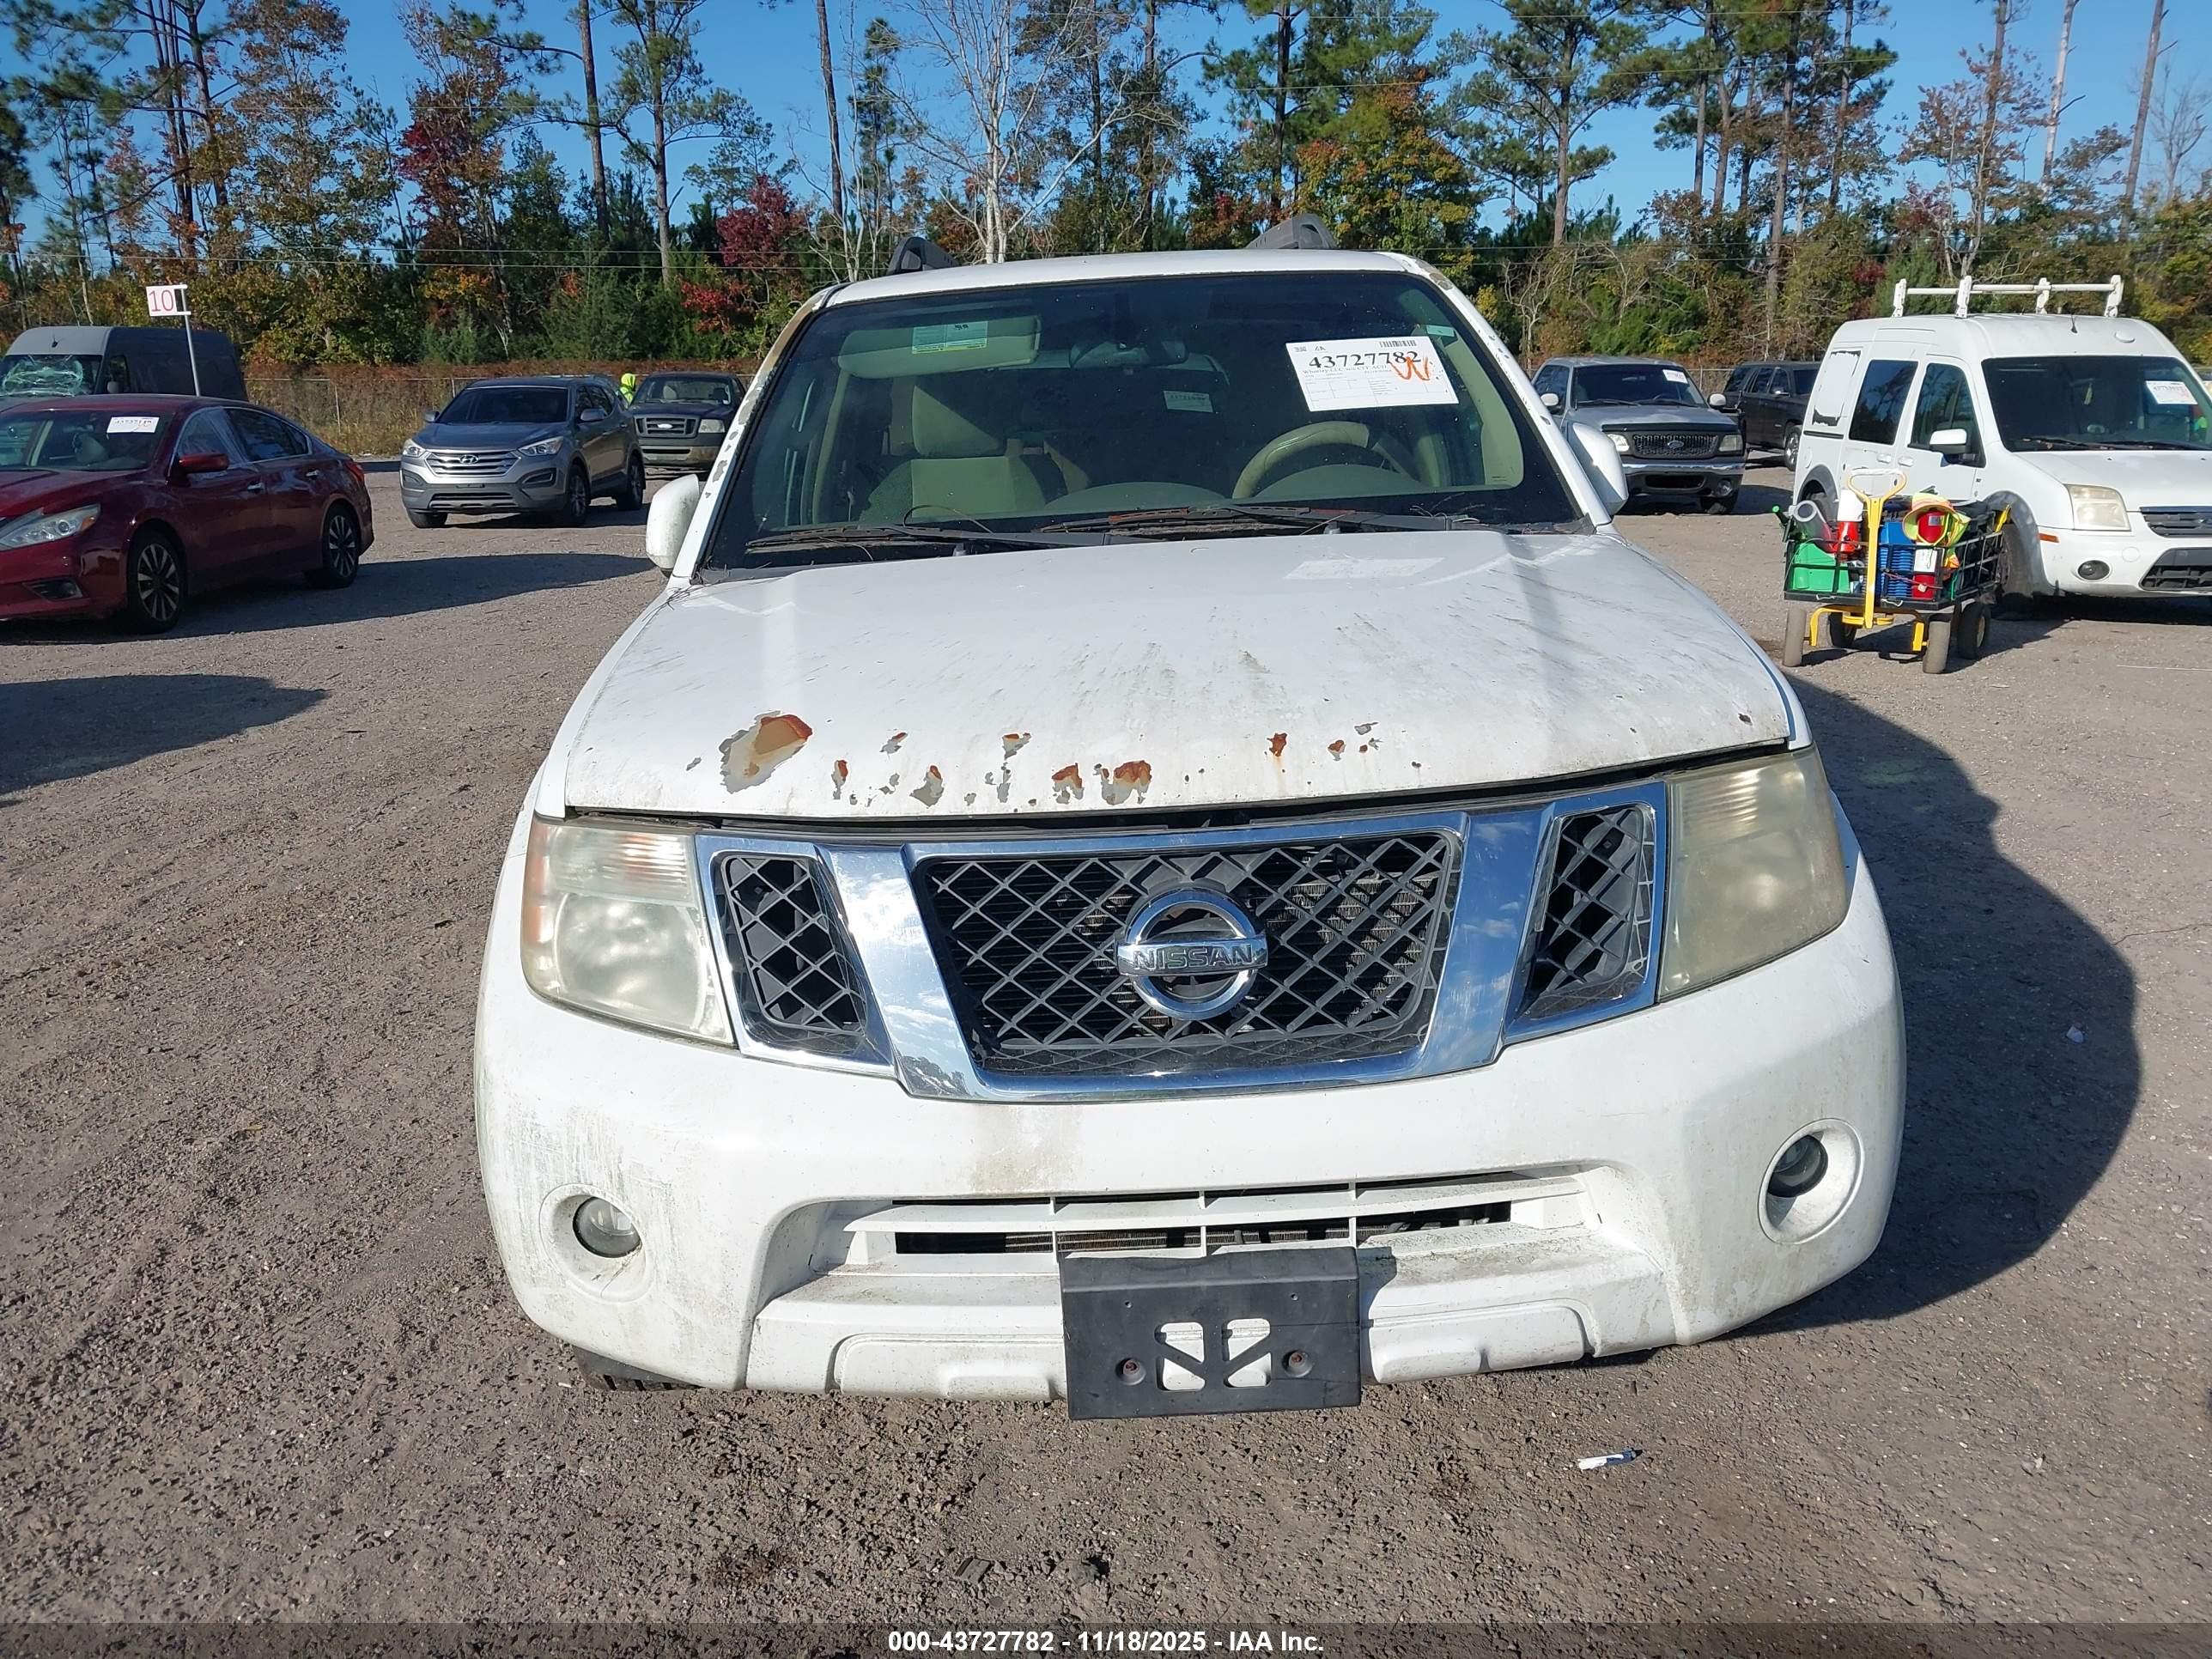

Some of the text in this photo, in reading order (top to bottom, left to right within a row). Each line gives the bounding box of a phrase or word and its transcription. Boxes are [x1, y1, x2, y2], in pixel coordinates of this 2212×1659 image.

[149, 289, 174, 312] 10
[1309, 350, 1422, 368] 43727782
[1133, 944, 1254, 971] NISSAN
